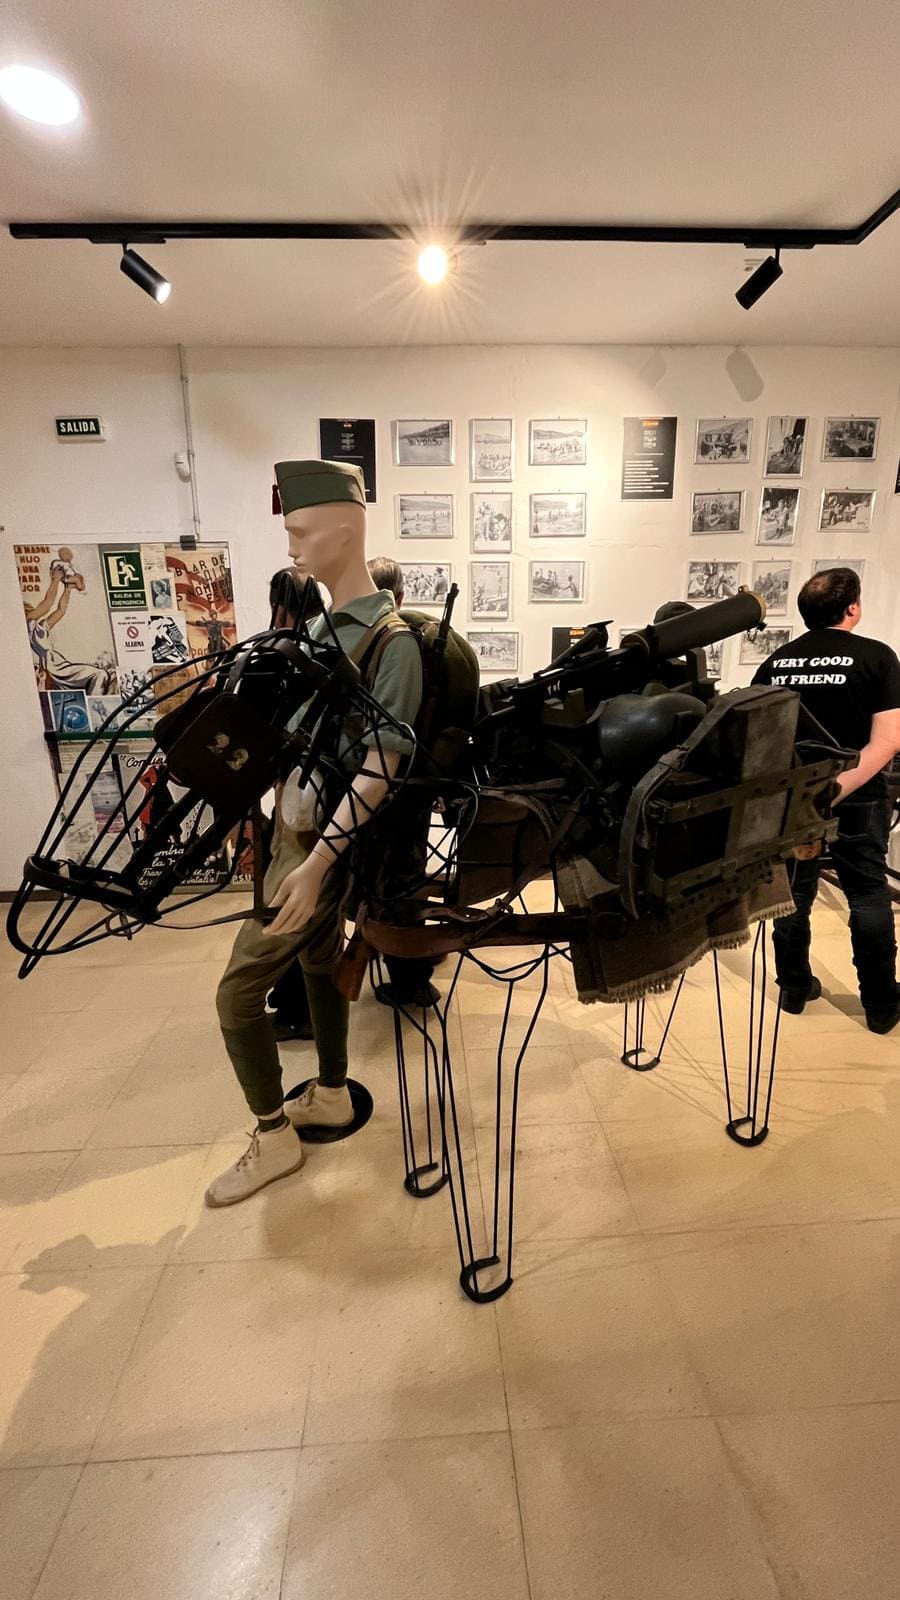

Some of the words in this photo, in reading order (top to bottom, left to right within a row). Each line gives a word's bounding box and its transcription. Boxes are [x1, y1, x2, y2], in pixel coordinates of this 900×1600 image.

[60, 421, 97, 433] SALIDA
[773, 658, 808, 669] VERY
[809, 656, 854, 667] GOOD
[771, 675, 788, 688] MY
[789, 673, 847, 685] FRIEND
